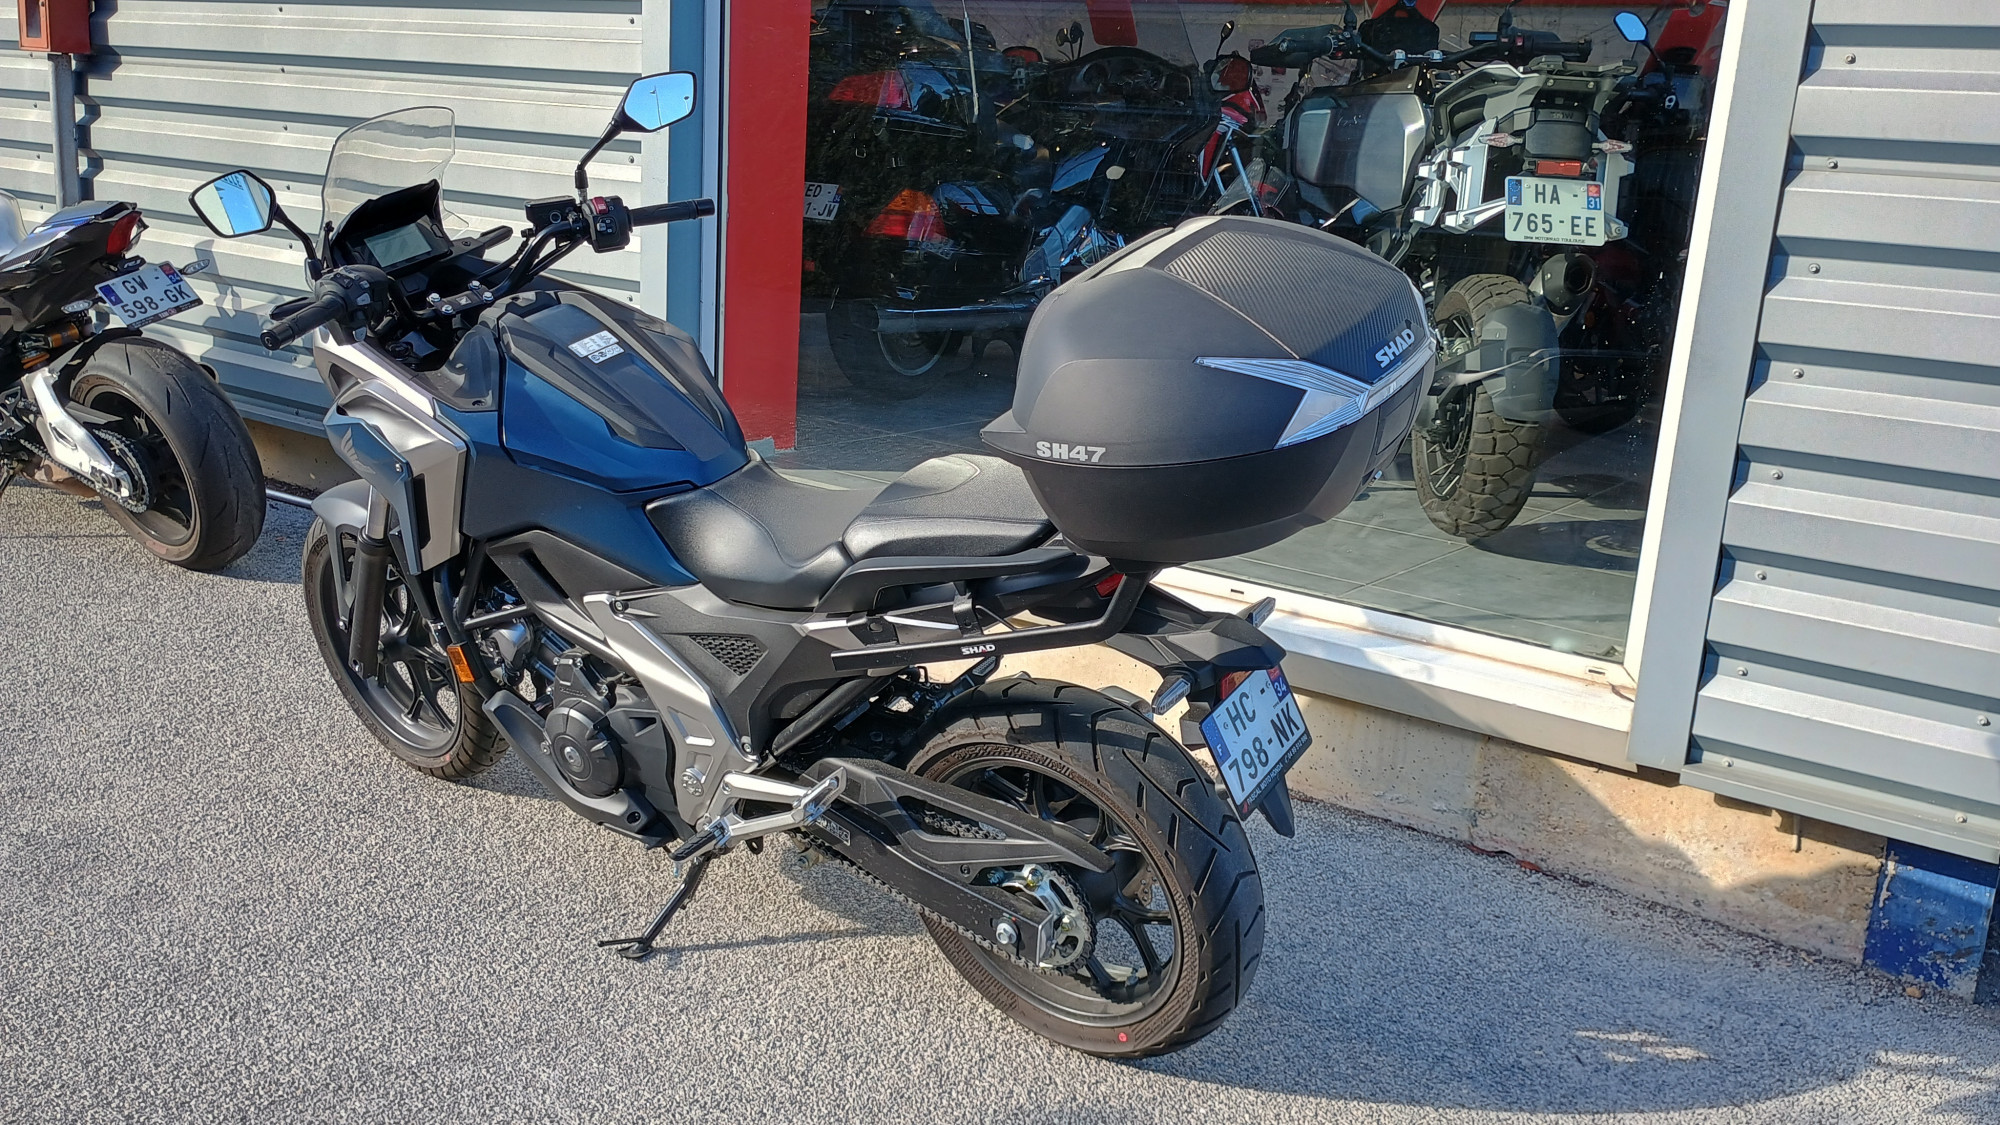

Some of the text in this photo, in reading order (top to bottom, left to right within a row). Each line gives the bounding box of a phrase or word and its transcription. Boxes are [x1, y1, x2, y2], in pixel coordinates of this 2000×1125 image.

[1534, 183, 1561, 205] HA
[1588, 197, 1600, 209] 31
[120, 284, 192, 319] 598-GK
[121, 275, 149, 295] GW
[168, 274, 180, 283] 34
[1375, 328, 1415, 369] SHAD
[1036, 440, 1106, 463] SH47
[961, 644, 996, 656] SHAD
[1225, 691, 1256, 737] HC
[1273, 676, 1287, 697] 34
[1228, 702, 1301, 793] 798-NK
[1247, 786, 1262, 805] PASCAL
[1260, 775, 1272, 791] MOTO
[1270, 762, 1283, 779] HONDA
